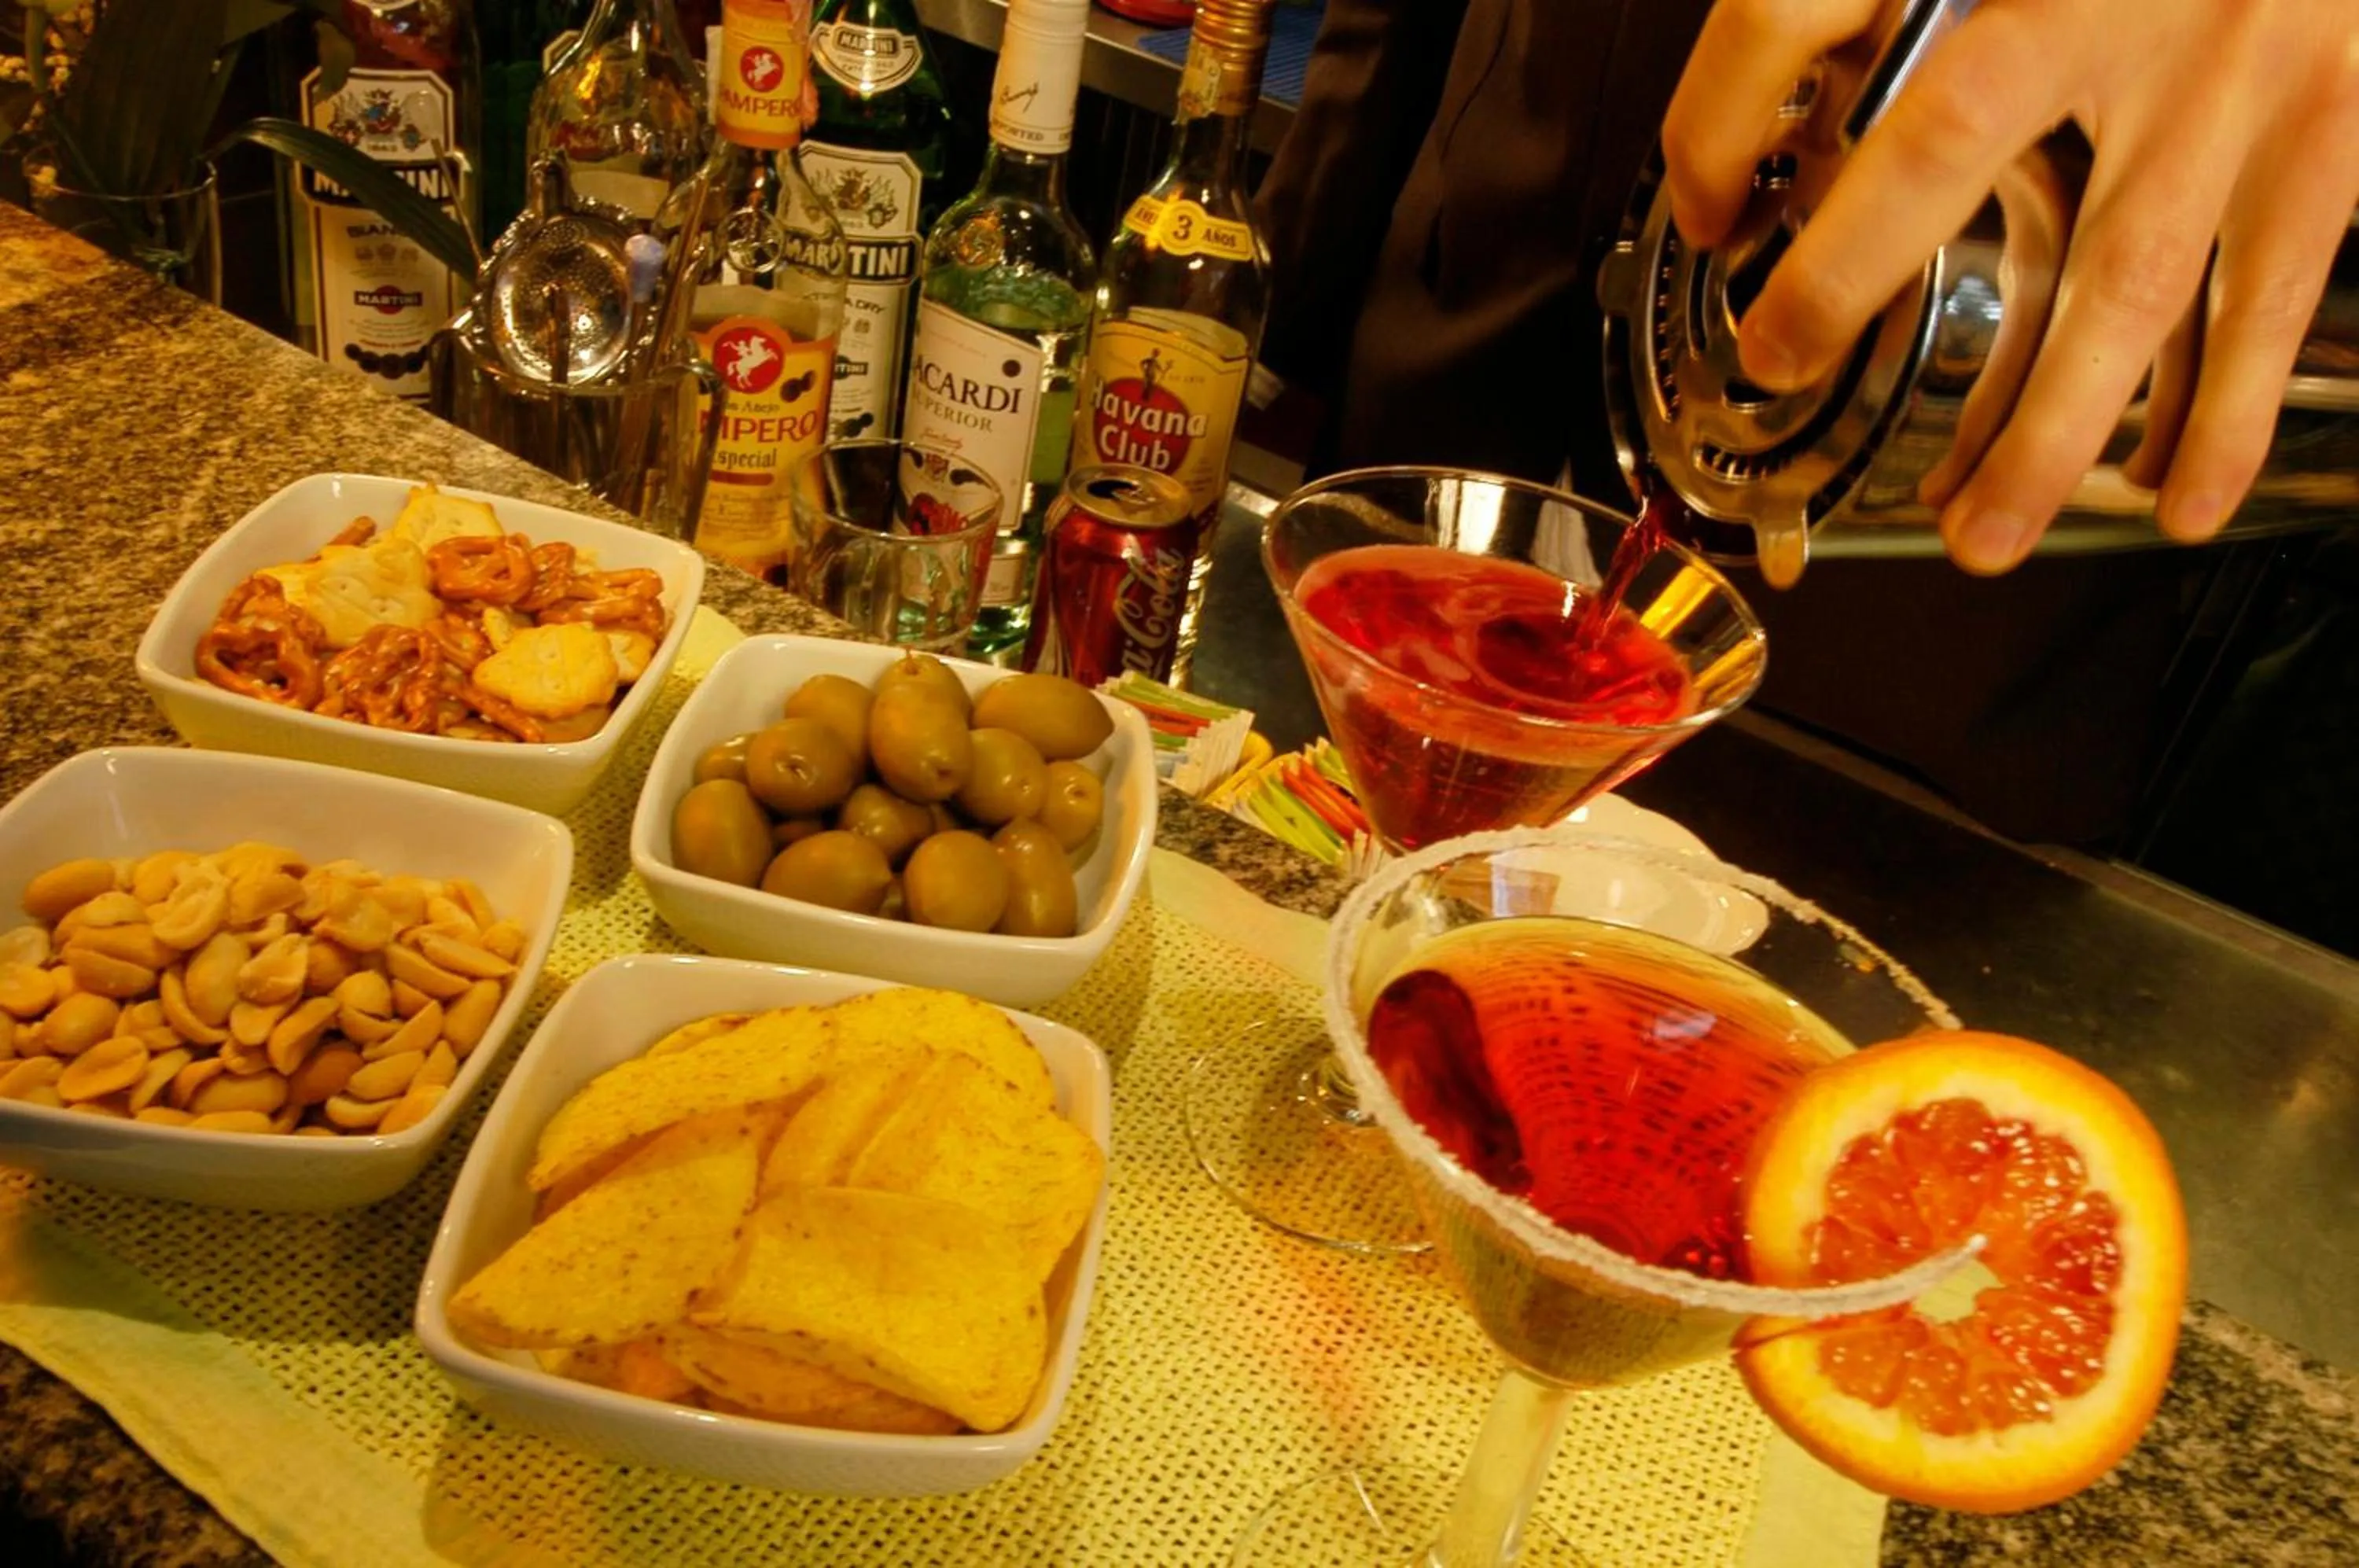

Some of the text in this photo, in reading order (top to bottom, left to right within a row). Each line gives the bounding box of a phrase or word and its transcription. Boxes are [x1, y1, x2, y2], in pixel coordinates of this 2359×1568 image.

[1172, 214, 1193, 241] 3
[712, 448, 778, 469] special
[1099, 425, 1171, 470] Club
